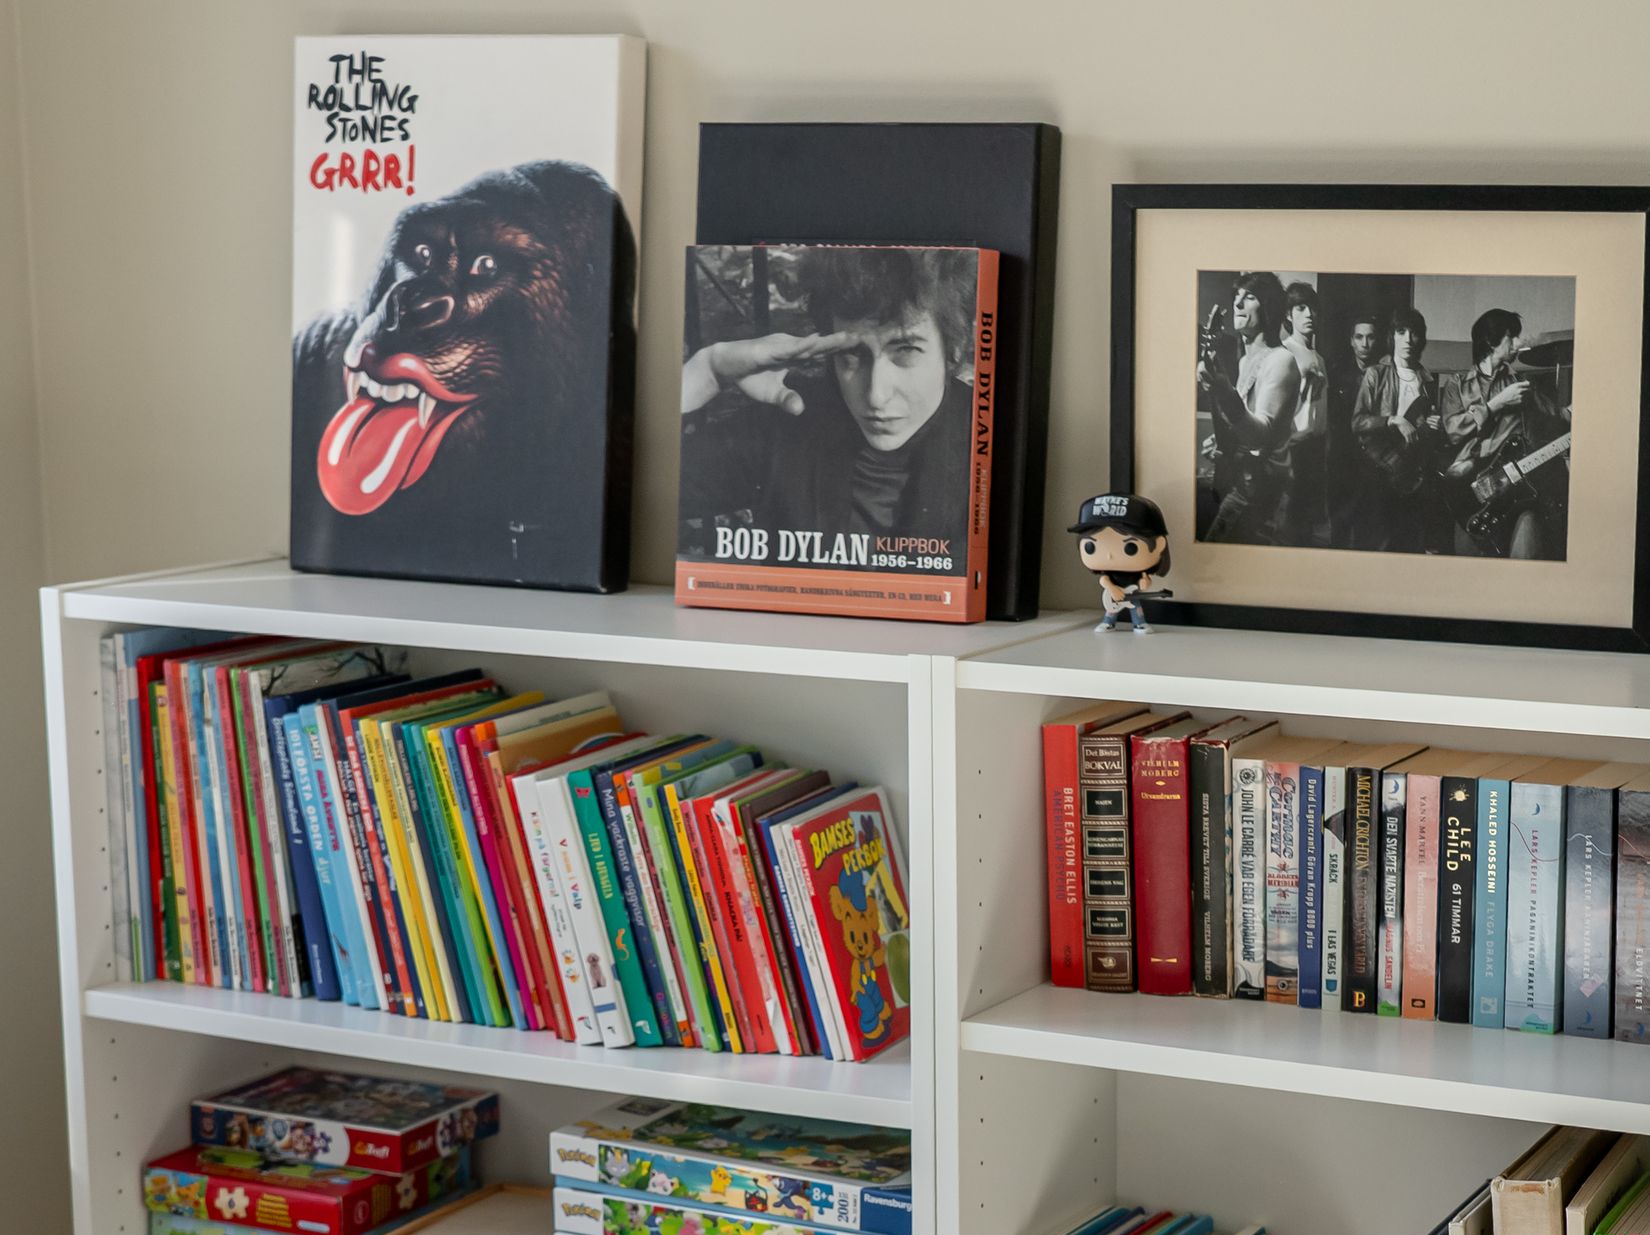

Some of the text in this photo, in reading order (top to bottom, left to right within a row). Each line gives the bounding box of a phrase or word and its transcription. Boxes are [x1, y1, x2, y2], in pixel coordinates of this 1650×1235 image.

[328, 50, 386, 84] THE
[308, 80, 419, 113] ROLLING
[325, 111, 411, 143] STONES
[310, 144, 416, 196] GRRR!
[977, 312, 993, 455] BOB DYLAN
[715, 527, 869, 566] BOB DYLAN
[876, 536, 950, 555] KLIPPBOK
[1086, 761, 1122, 770] BOKVAL
[1307, 778, 1316, 801] David
[305, 804, 324, 850] ORDEN
[1306, 804, 1315, 853] Lagercrantz
[1355, 774, 1370, 871] MICHAEL CRICHTON
[1386, 816, 1397, 835] DEN
[601, 787, 646, 928] Mina vackraste vaggvisor
[810, 818, 856, 870] BAMSES
[842, 838, 884, 876] PEKBOK
[1063, 787, 1076, 904] BRET EASTON ELLIS
[1240, 788, 1258, 904] JOHN LE CARRÉ EGEN
[1385, 837, 1397, 872] SVARTE
[1446, 816, 1459, 870] CHILD
[1460, 827, 1471, 861] LEE
[1584, 835, 1592, 858] LARS
[1307, 856, 1315, 879] Göran
[1485, 790, 1496, 976] KHALED HOSSEINI FLYGA DRAKE
[568, 883, 583, 910] Valp
[1304, 882, 1314, 906] Kropp
[1384, 874, 1396, 919] NAZISTEN
[1451, 883, 1461, 943] 61 TIMMAR
[1305, 931, 1314, 948] plus
[1327, 935, 1336, 948] LAS
[1527, 899, 1536, 1007] PAGANINIKONTRAKTET
[1327, 951, 1336, 973] VEGAS
[1634, 947, 1643, 1010] ELDVITTNET
[812, 1187, 827, 1201] 8+
[837, 1199, 849, 1223] 200
